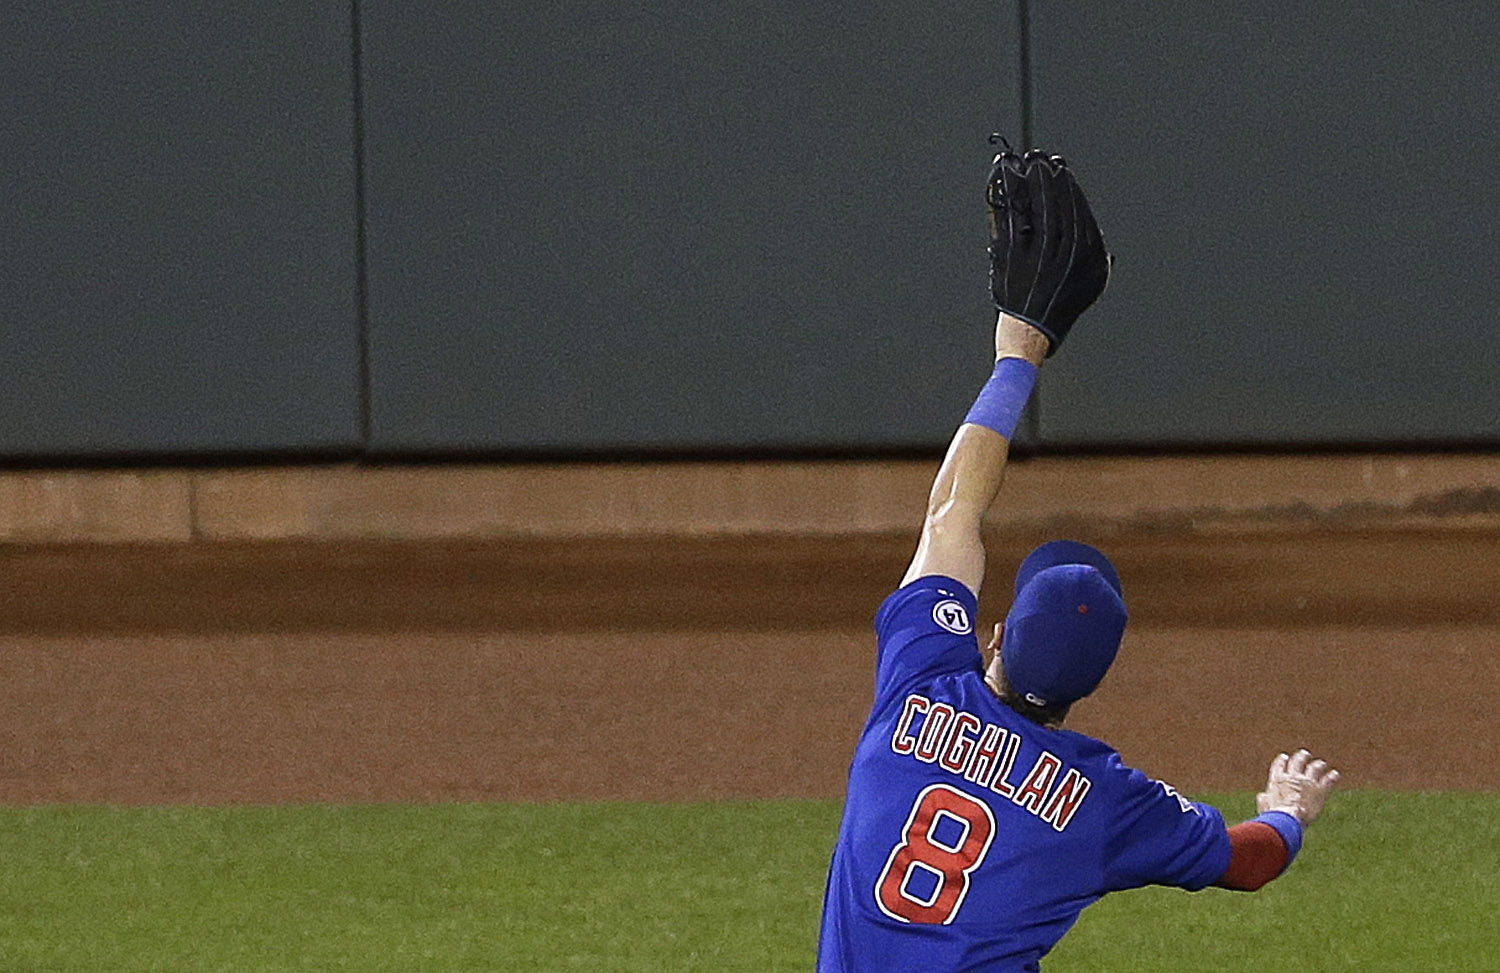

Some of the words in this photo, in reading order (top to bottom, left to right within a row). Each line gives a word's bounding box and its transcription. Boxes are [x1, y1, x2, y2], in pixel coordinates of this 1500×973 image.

[943, 608, 966, 627] 14
[892, 694, 1091, 831] COGHLAN
[874, 784, 996, 925] 8
